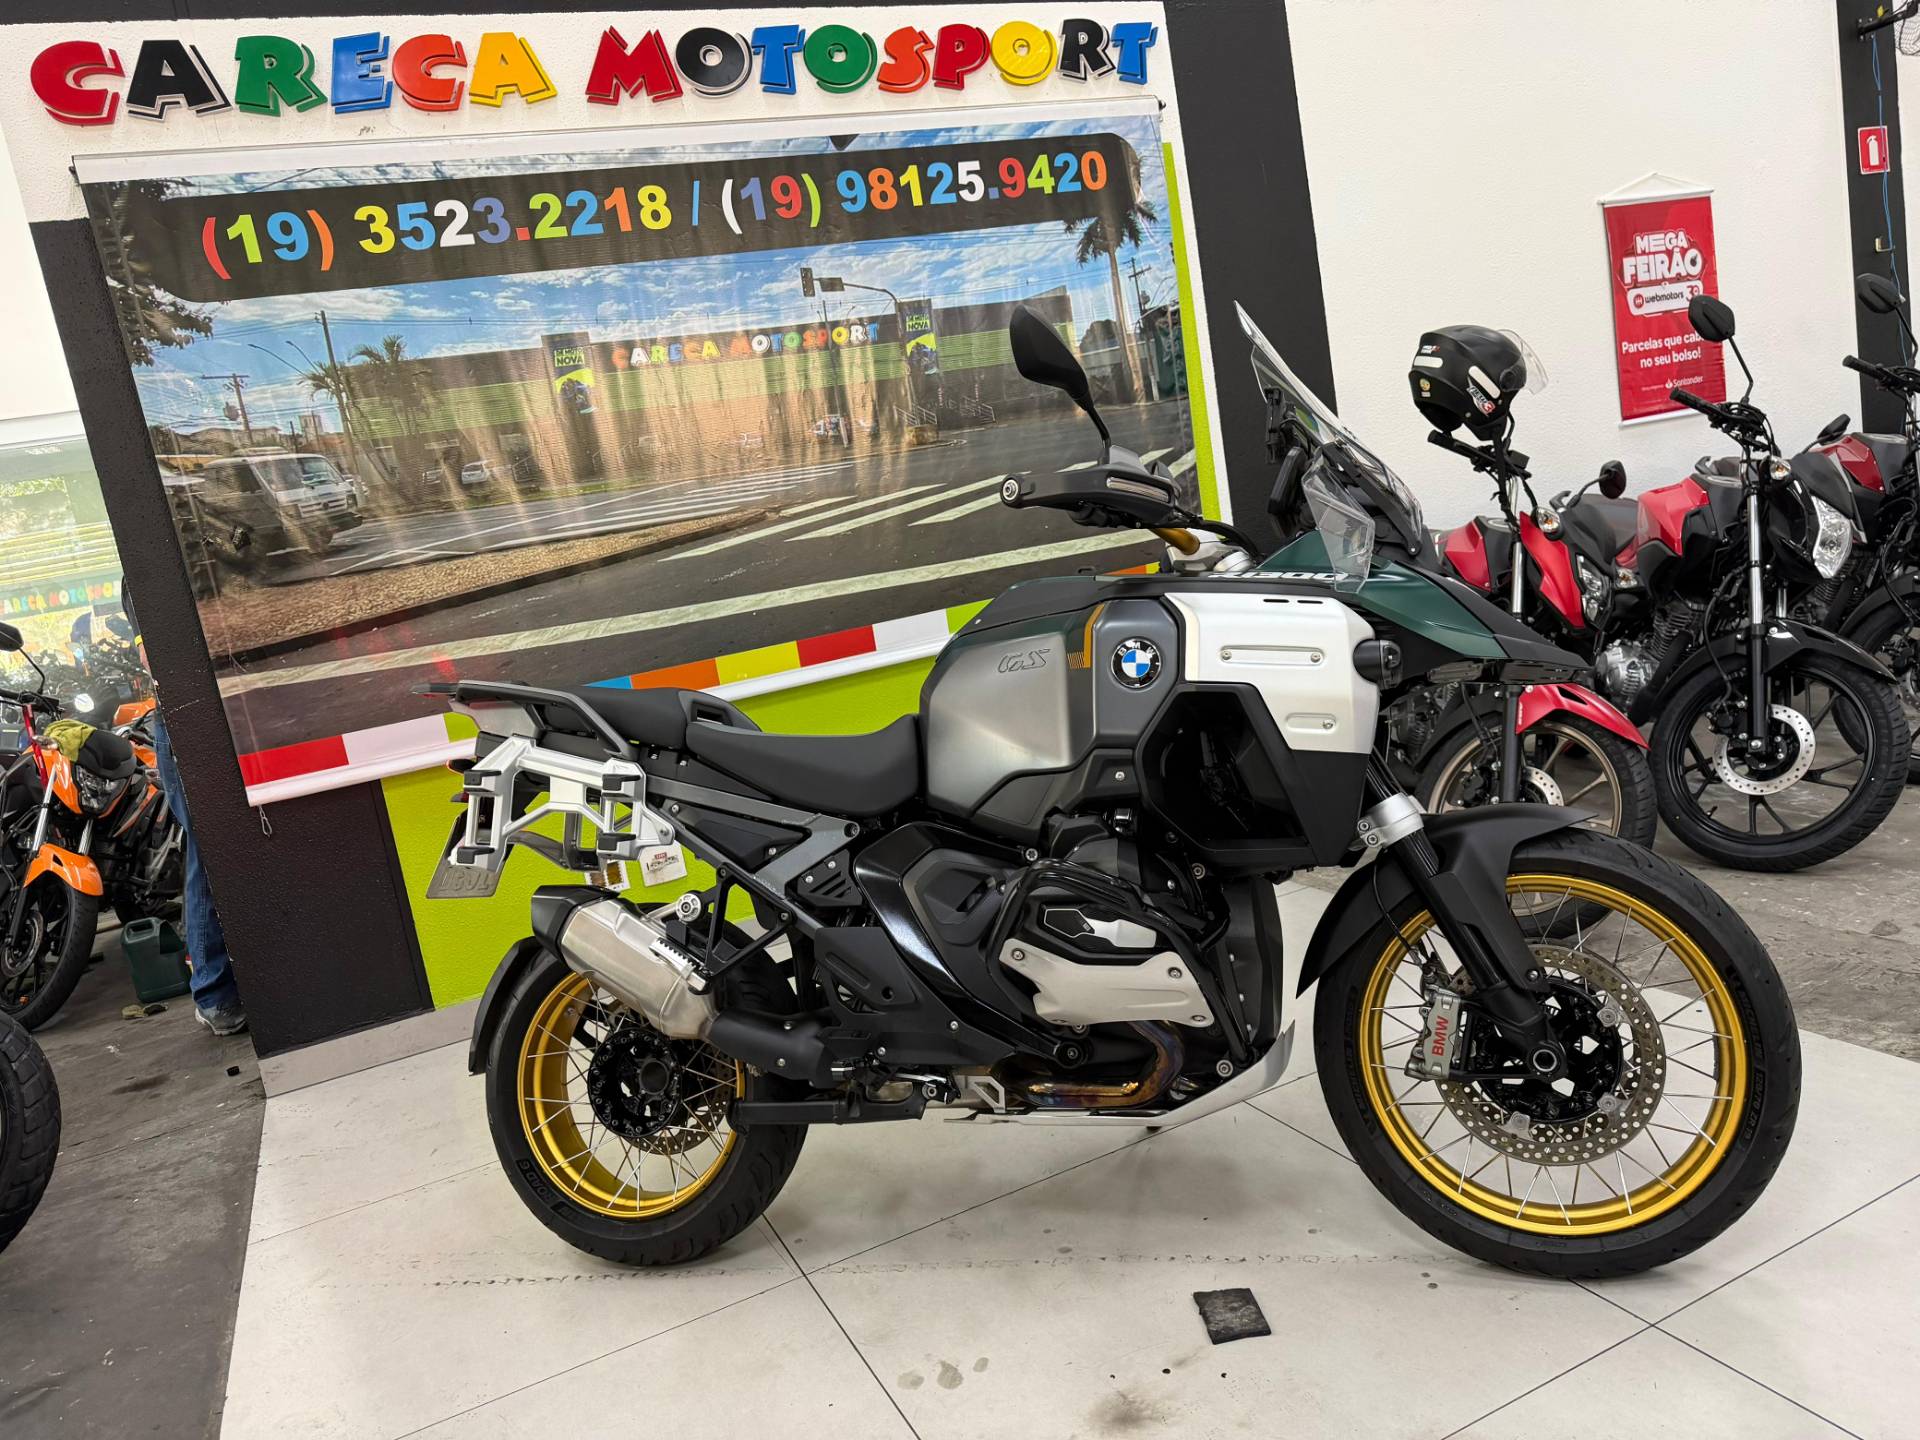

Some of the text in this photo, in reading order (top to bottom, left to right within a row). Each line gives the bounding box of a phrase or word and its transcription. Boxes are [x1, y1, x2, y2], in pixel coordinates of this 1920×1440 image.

[30, 18, 1158, 126] CARECA MOTOSPORT
[202, 151, 1107, 280] (19) 3523.2218 / (19) 98125.9420
[1635, 231, 1688, 254] MEGA
[1623, 247, 1703, 284] FEIRÃO
[1644, 291, 1684, 304] webmotors
[1621, 331, 1704, 354] Parcelas que cab
[556, 356, 584, 366] NOVA
[612, 340, 720, 370] CARECA
[1640, 346, 1702, 368] no seu bolso!
[1673, 375, 1703, 387] Santander
[1431, 1015, 1449, 1056] BMW
